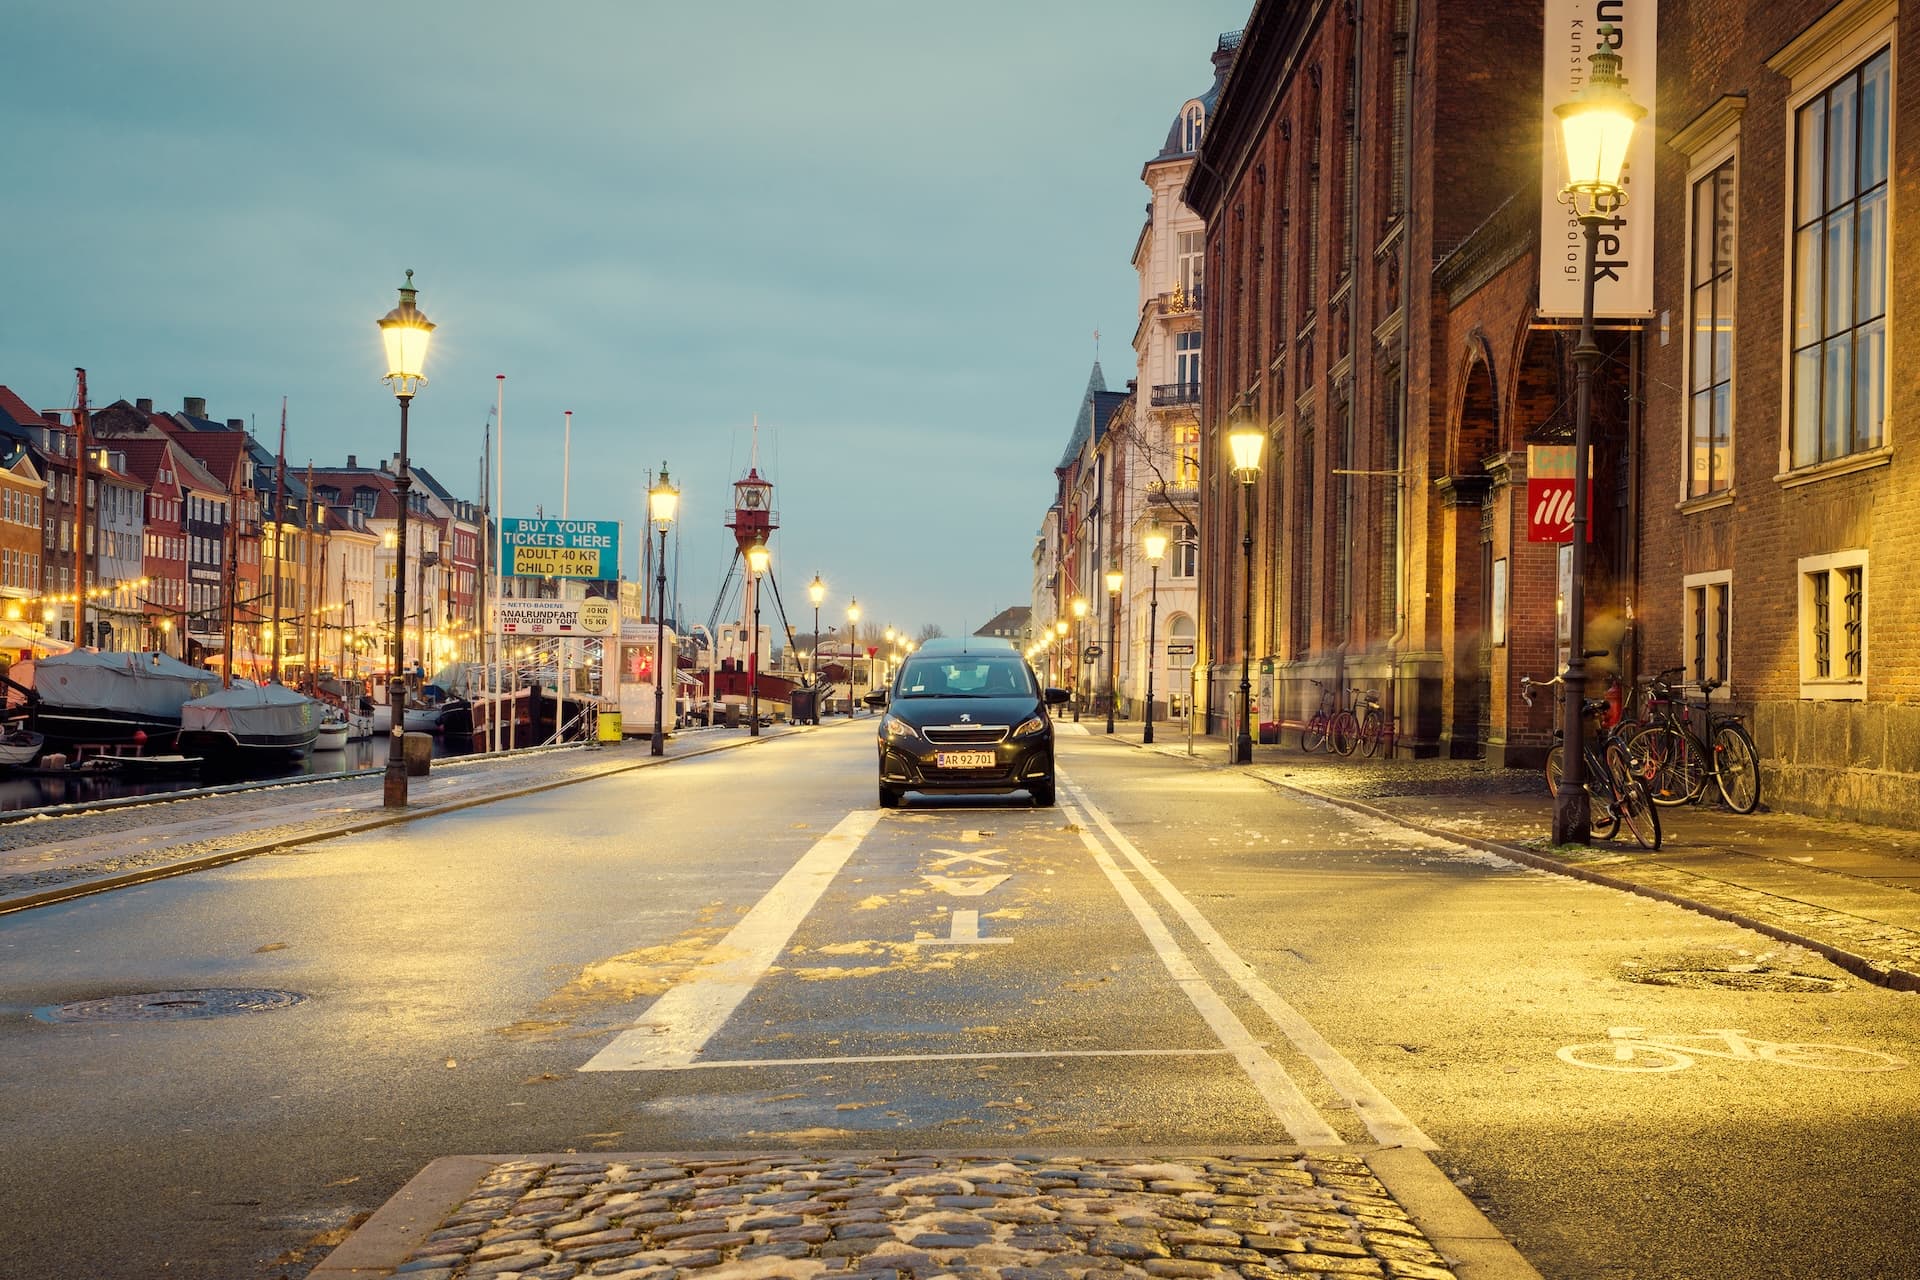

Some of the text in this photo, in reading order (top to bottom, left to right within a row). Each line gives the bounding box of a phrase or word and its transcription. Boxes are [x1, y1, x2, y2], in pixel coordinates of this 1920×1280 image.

[518, 520, 597, 534] BUY YOUR
[503, 532, 611, 548] TICKETS HERE
[517, 548, 598, 561] ADULT 40 KR
[516, 562, 593, 575] CHILD 15 KR
[945, 755, 958, 765] AR
[960, 755, 973, 765] 92
[975, 754, 992, 764] 701
